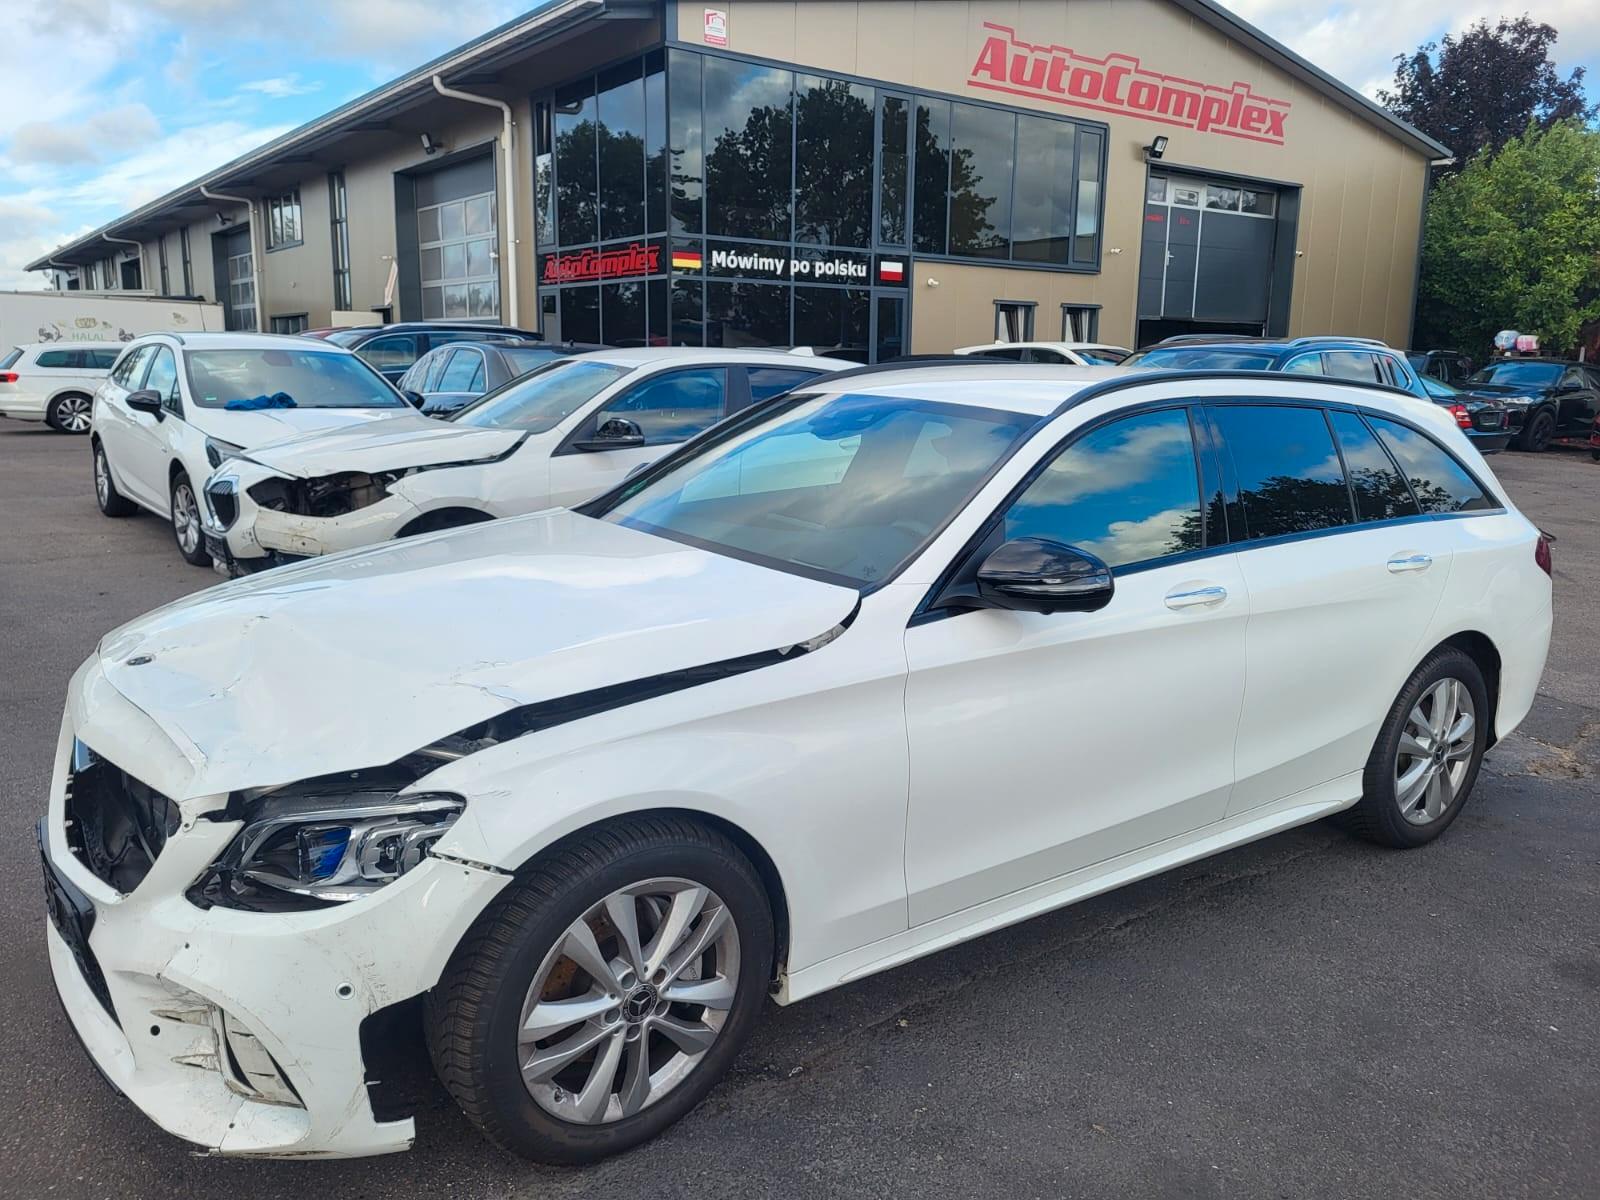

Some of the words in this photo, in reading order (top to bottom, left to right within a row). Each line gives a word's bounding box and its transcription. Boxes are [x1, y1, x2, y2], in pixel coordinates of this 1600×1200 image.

[971, 36, 1289, 138] AutoComplex
[544, 249, 659, 279] AutoComplex
[711, 250, 785, 275] Mówimy
[790, 259, 810, 276] po
[815, 259, 867, 278] polsku
